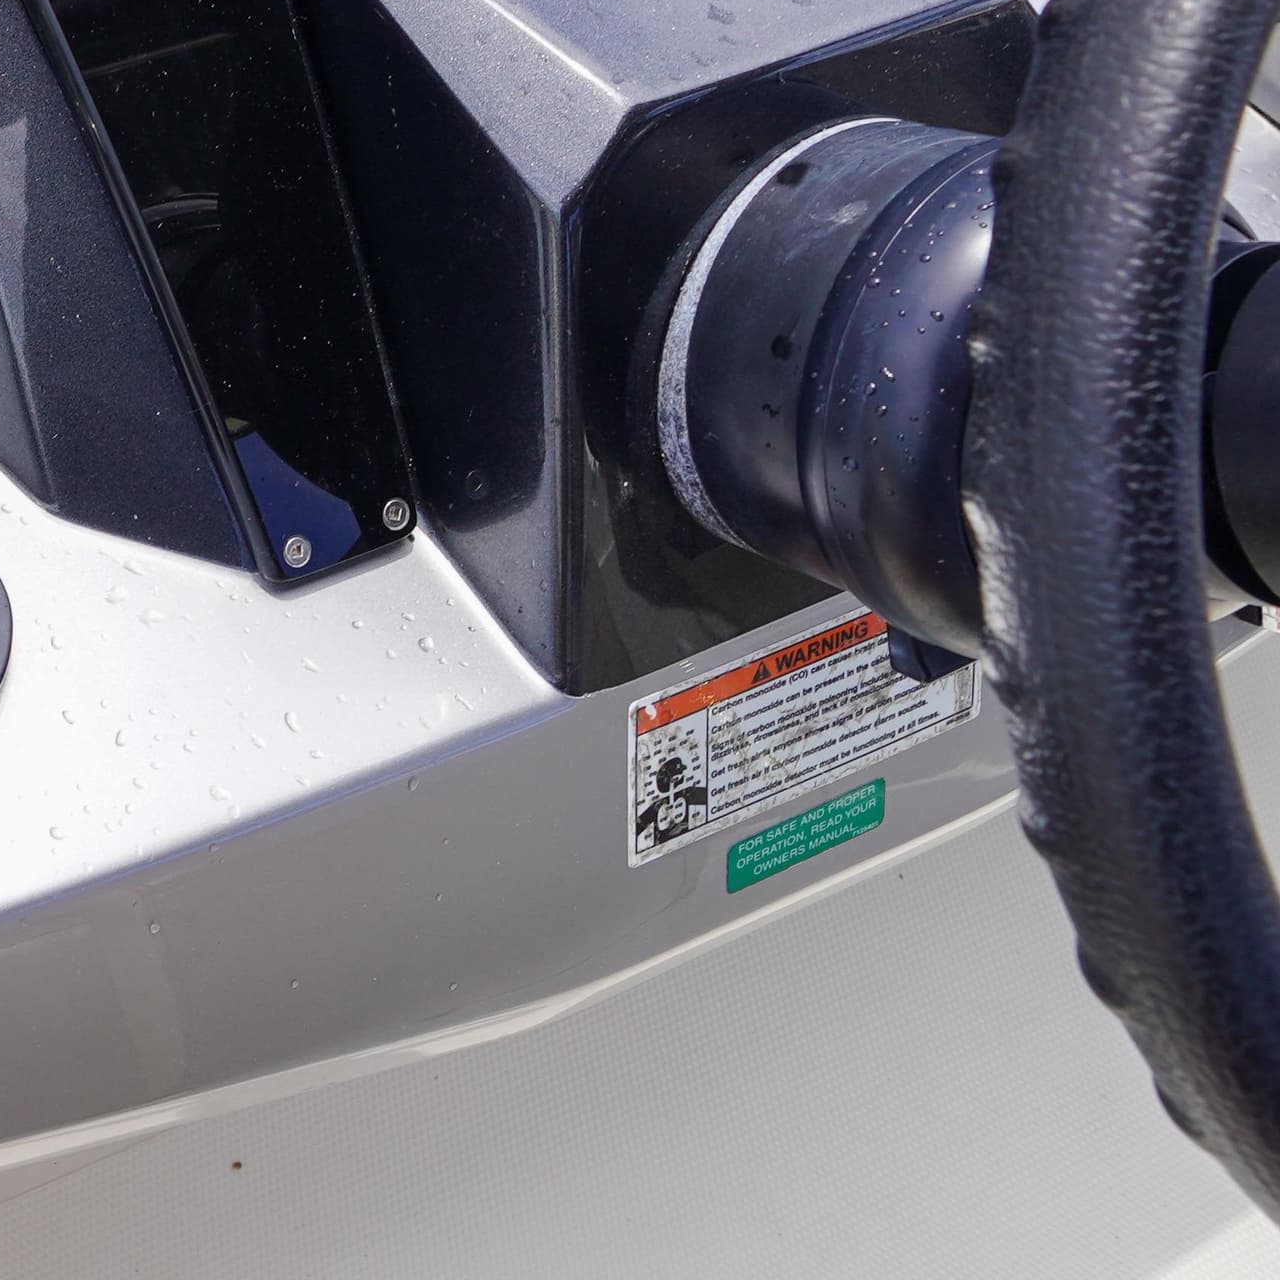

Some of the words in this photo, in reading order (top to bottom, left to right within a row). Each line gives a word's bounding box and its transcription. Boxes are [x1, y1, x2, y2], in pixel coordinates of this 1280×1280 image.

[775, 621, 869, 672] WARNING
[743, 699, 783, 721] monoxide
[785, 691, 800, 703] can
[814, 672, 844, 693] present
[745, 678, 786, 702] monoxide
[788, 668, 808, 686] (CO)
[810, 662, 825, 674] can
[746, 720, 775, 737] carbon
[777, 703, 816, 724] monoxide
[710, 785, 725, 797] Get
[727, 775, 748, 790] fresh
[838, 723, 872, 742] detector
[710, 767, 725, 779] Get
[710, 797, 740, 815] Carbon
[742, 779, 782, 801] monoxide
[811, 812, 842, 836] READ
[845, 796, 876, 820] YOUR
[738, 834, 763, 855] FOR
[766, 819, 796, 842] SAFE
[799, 806, 824, 827] AND
[828, 783, 876, 814] PROPER
[753, 843, 805, 876] OWNERS
